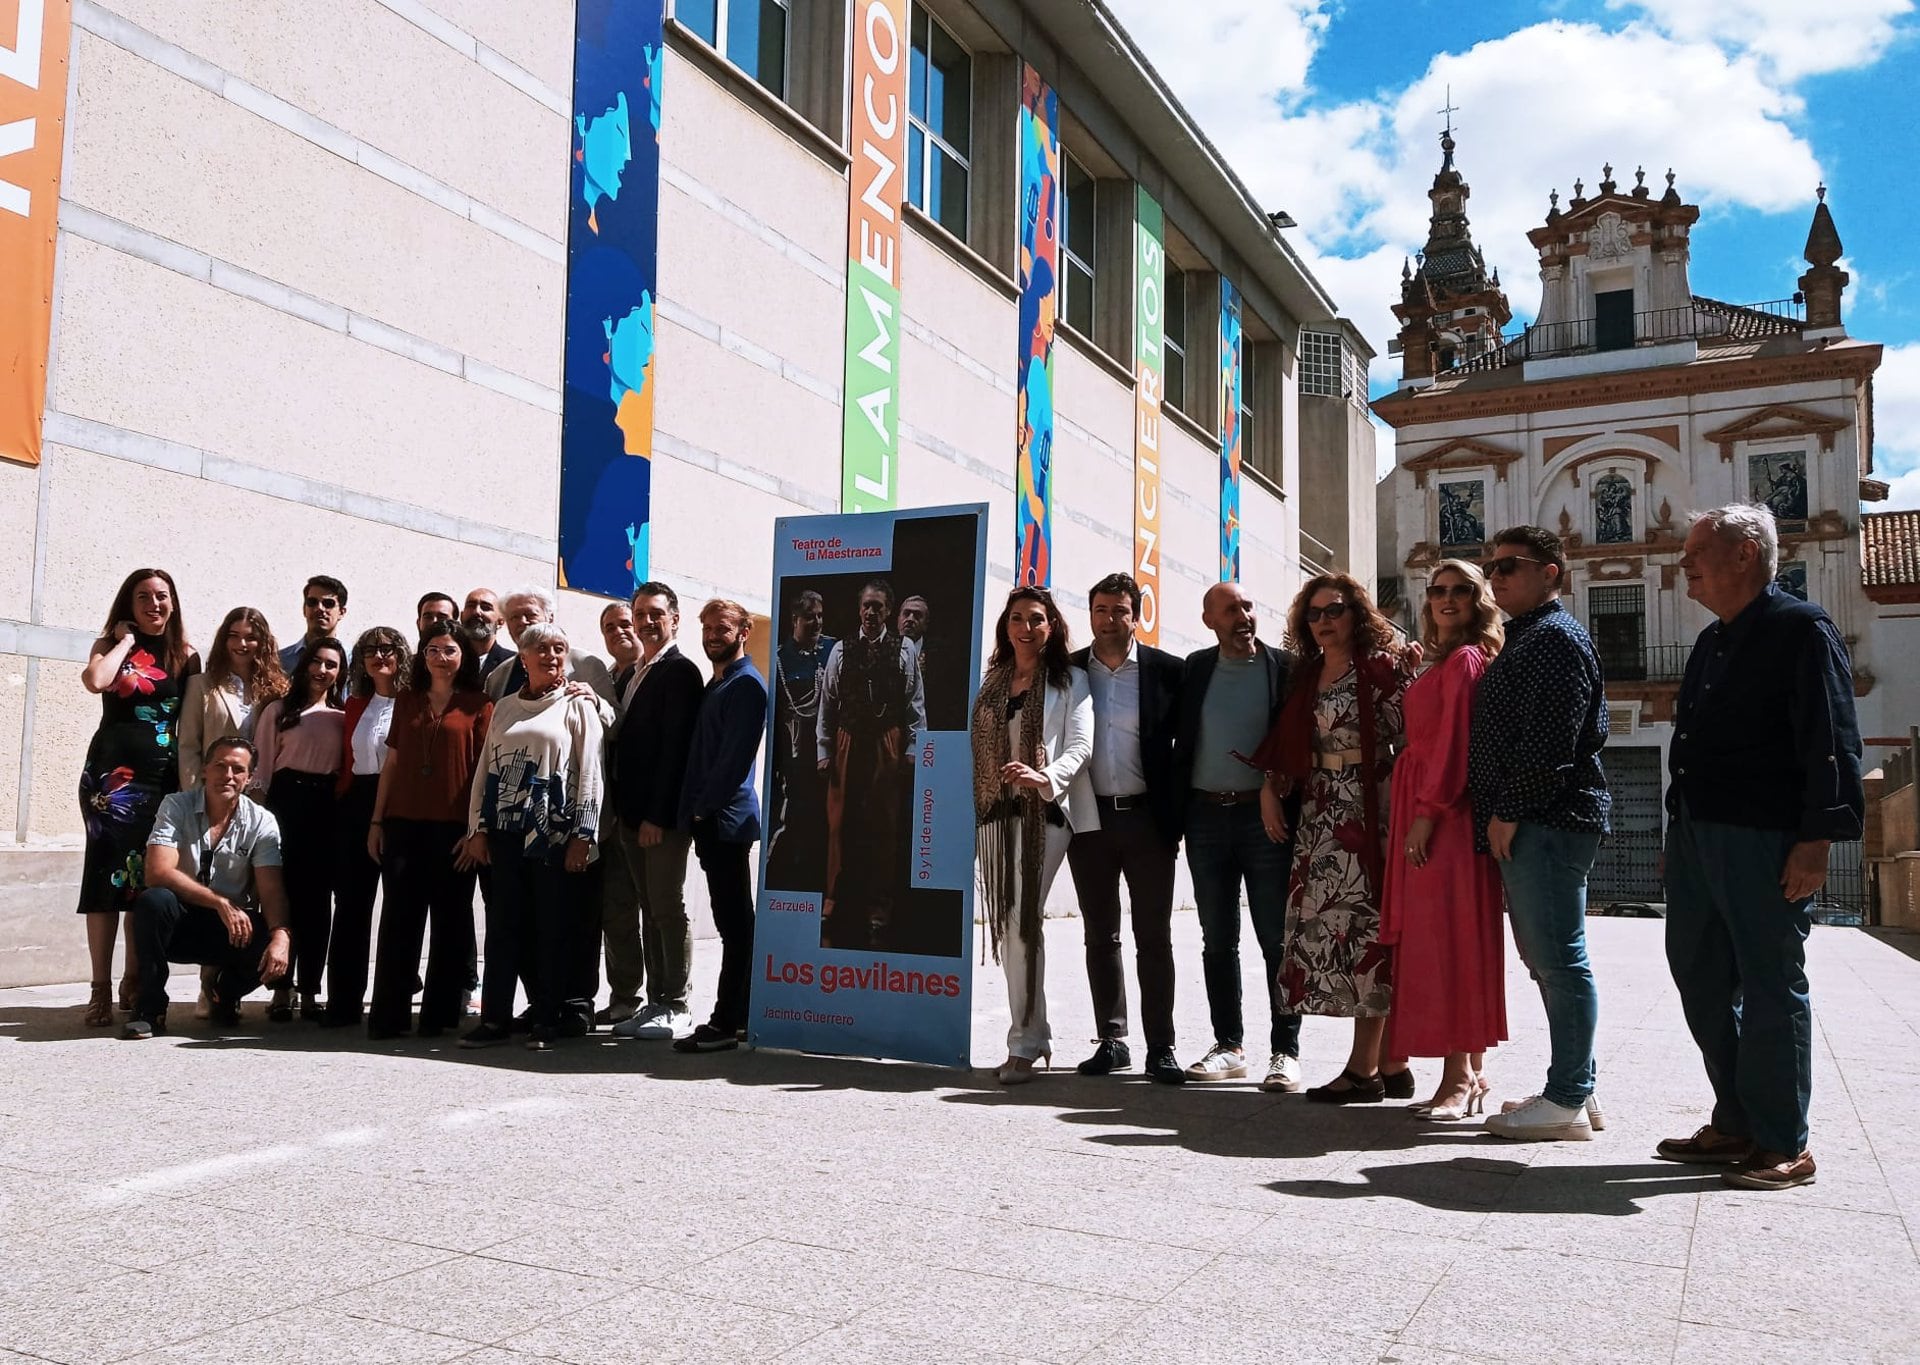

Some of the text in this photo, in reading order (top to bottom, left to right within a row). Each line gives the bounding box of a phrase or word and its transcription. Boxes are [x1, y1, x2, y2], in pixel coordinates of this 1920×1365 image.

[855, 1, 899, 513] LAMENCO
[1139, 232, 1160, 647] ONCIERTOS
[792, 537, 841, 549] Teatro de
[806, 547, 882, 560] la Maestranza
[919, 739, 934, 880] 9 y 11 de mayo 20h.
[769, 899, 815, 912] Zarzuela
[766, 954, 961, 997] Los gavilanes
[763, 1007, 854, 1025] Jacinto Guerrero
